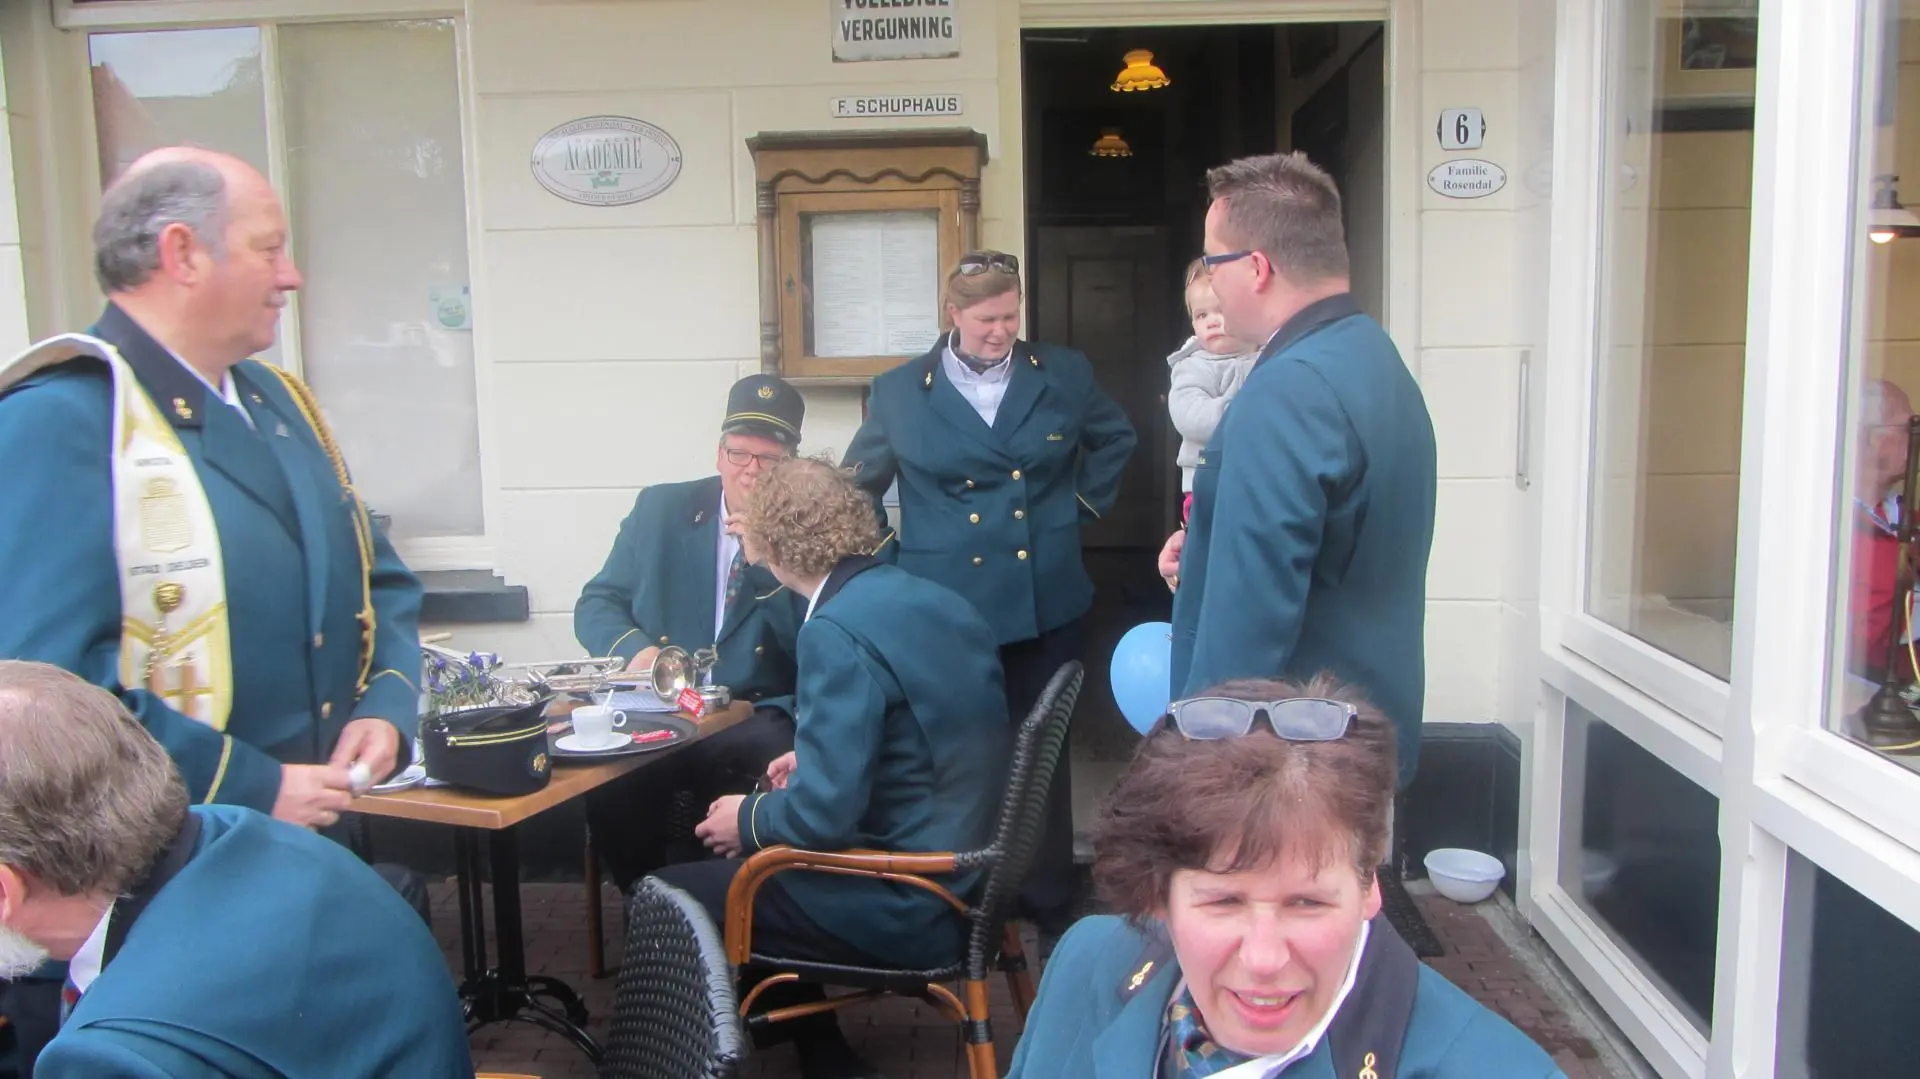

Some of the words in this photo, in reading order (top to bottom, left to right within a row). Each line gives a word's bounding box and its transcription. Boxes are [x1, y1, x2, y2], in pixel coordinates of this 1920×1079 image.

[841, 17, 953, 42] VERGUNNING
[838, 100, 850, 115] F.
[856, 98, 958, 114] SCHUPHAUS
[1455, 113, 1469, 145] 6
[564, 135, 643, 171] ACADEMIE
[1447, 165, 1489, 176] Familie
[1443, 180, 1492, 190] Rosendal
